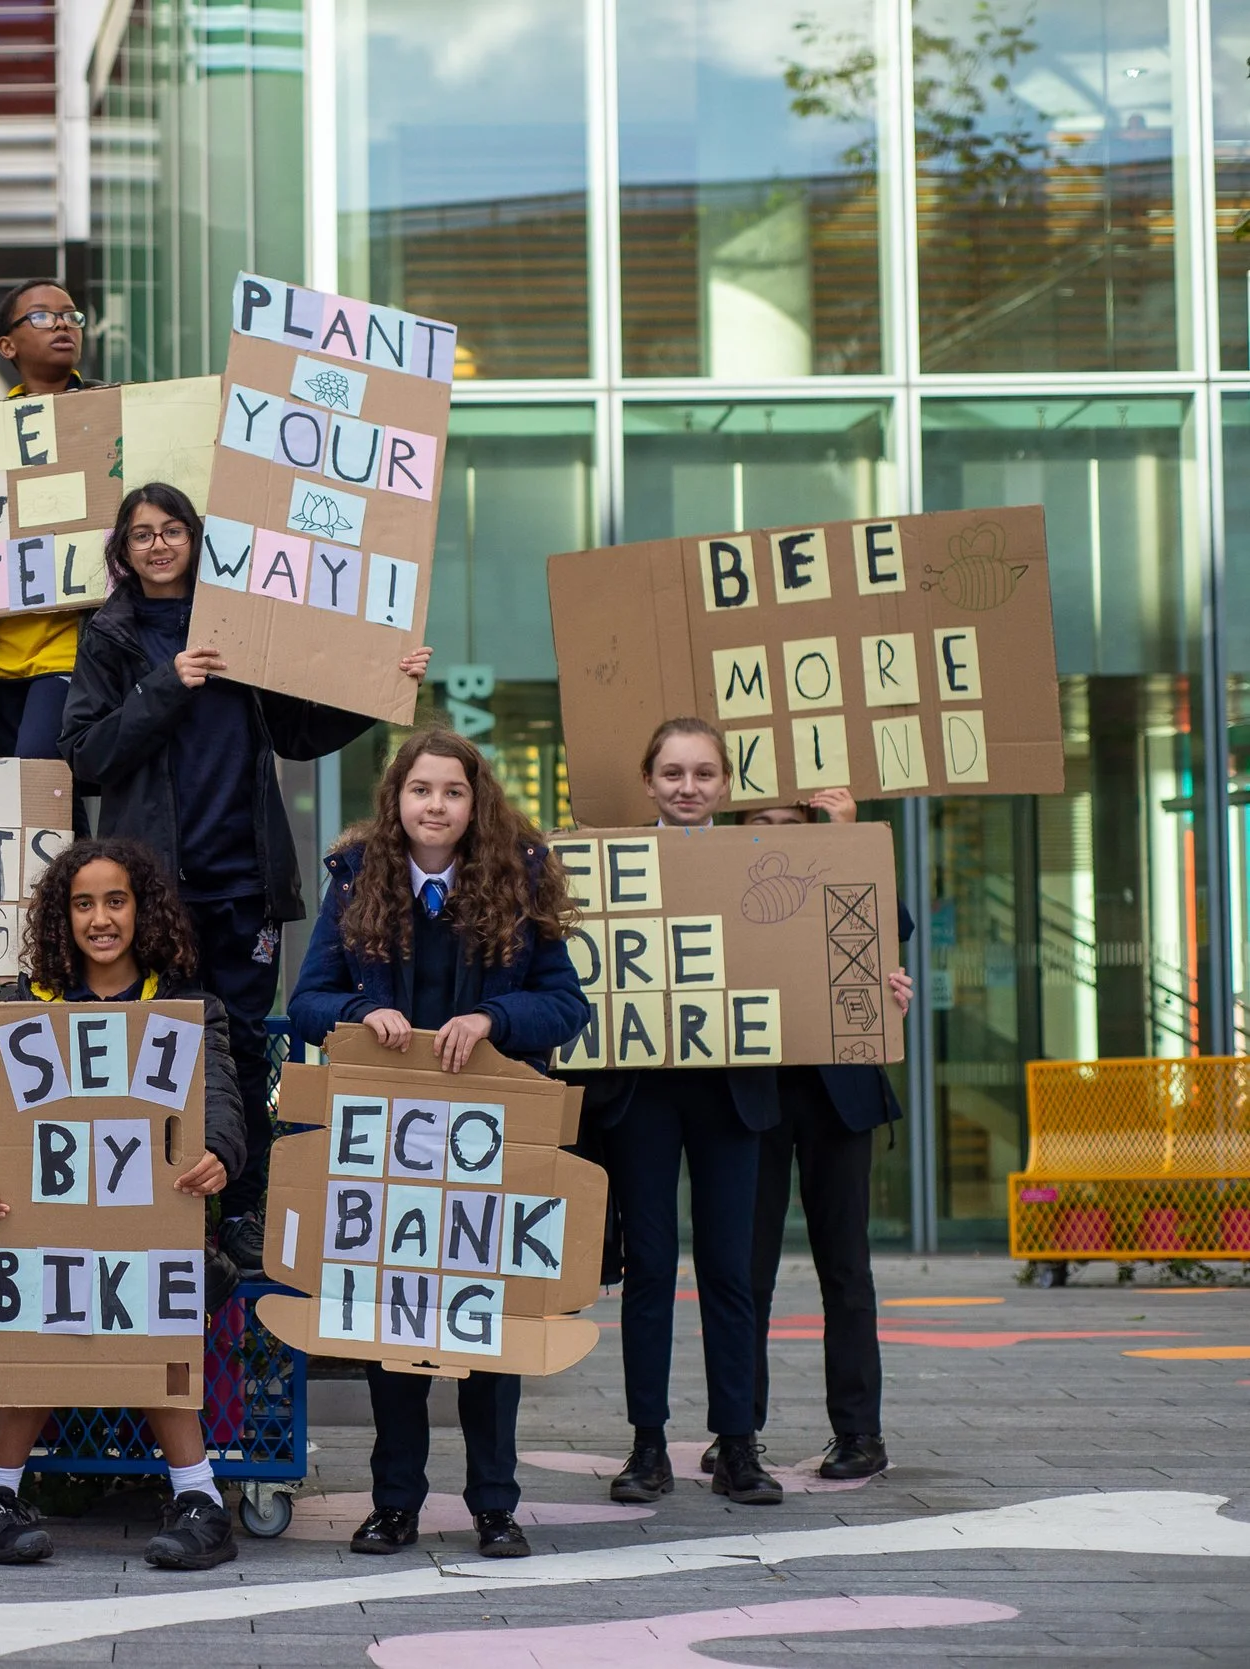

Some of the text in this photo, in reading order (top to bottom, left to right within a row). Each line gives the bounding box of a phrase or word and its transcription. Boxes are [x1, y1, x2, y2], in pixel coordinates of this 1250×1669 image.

[241, 280, 454, 378] PLANT
[236, 392, 422, 489] YOUR
[204, 534, 398, 622] WAY!
[709, 523, 898, 607] BEE
[725, 635, 968, 701] MORE
[447, 665, 495, 758] BA
[738, 716, 978, 793] KIND
[553, 844, 649, 907] EE
[567, 924, 714, 989] ORE
[8, 1019, 178, 1103] SE1
[559, 996, 770, 1064] WARE
[38, 1123, 141, 1196] BY
[338, 1105, 502, 1172] ECO
[335, 1188, 562, 1270] BANK
[341, 1268, 495, 1345] ING
